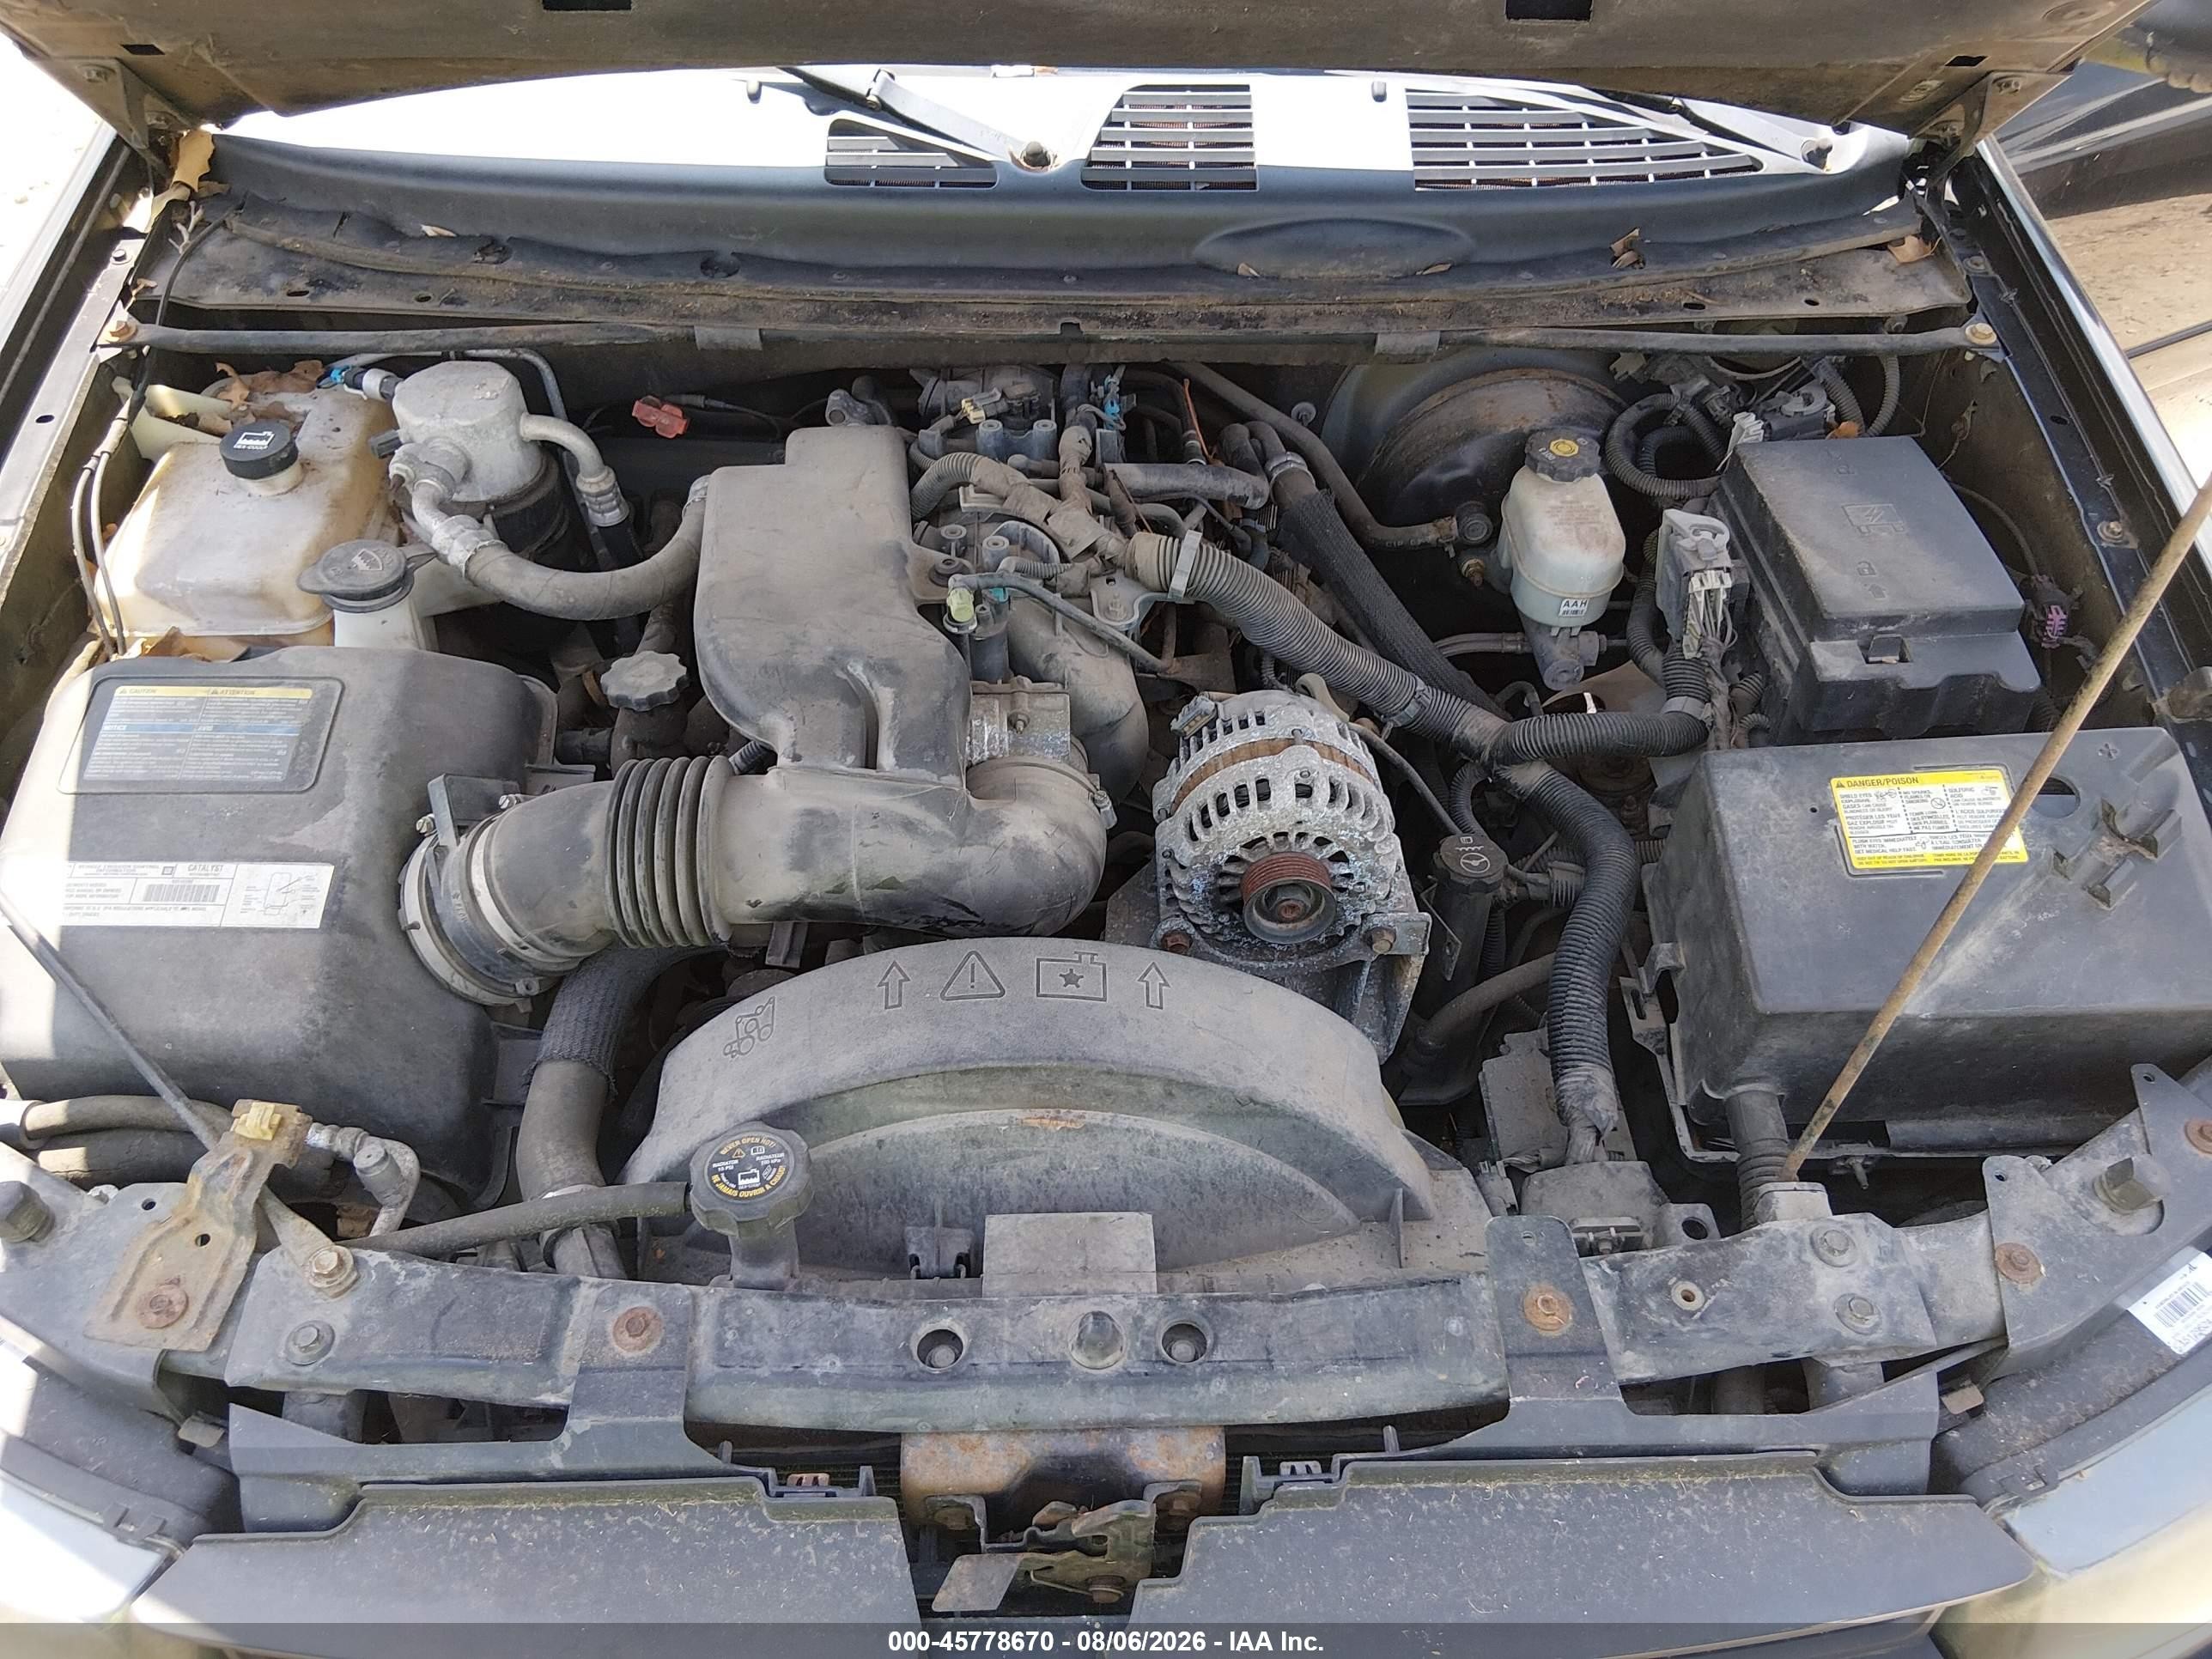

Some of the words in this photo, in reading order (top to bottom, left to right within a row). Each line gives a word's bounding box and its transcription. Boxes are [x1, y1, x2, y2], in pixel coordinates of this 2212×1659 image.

[1563, 599, 1588, 608] AAH
[1847, 777, 1919, 787] DANGER/POISON
[712, 1159, 739, 1168] RADIATOR
[738, 1186, 766, 1198] OUVRIR
